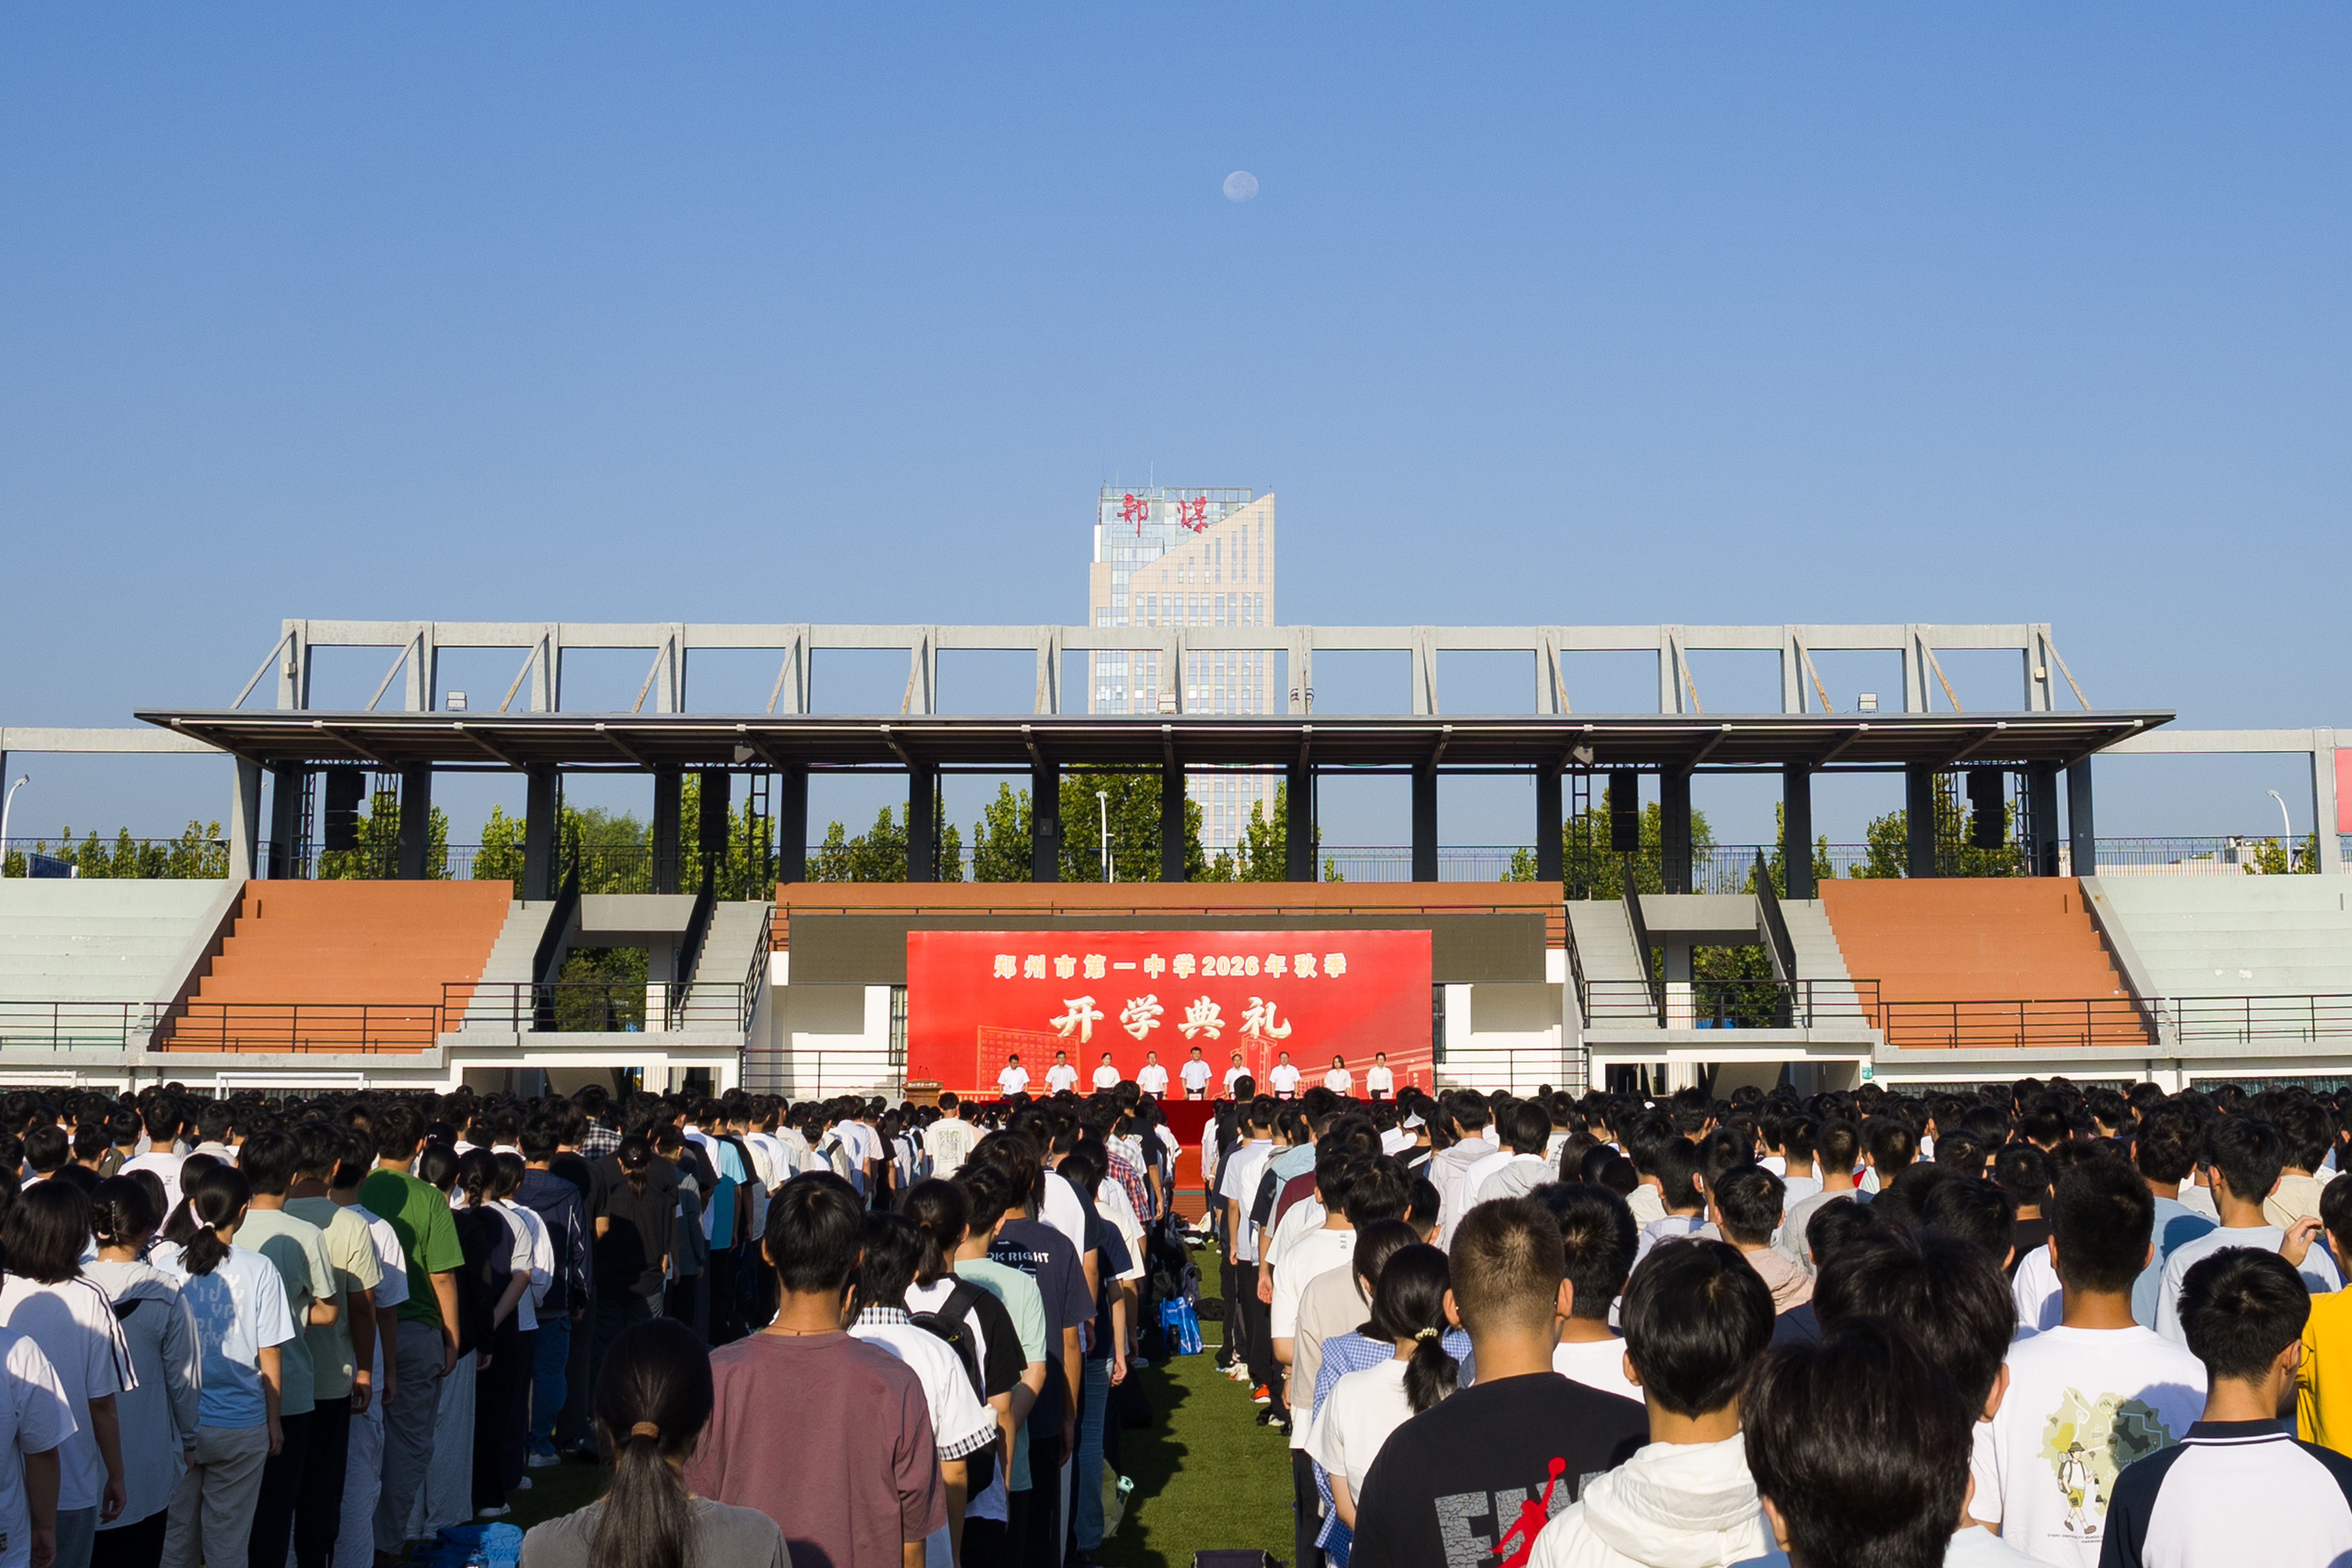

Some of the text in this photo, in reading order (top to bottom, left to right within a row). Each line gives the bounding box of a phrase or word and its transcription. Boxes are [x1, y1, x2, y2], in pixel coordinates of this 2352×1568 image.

[994, 953, 1347, 979] 郑州市第一中学2026年秋季
[1049, 994, 1292, 1043] 开学典礼
[1009, 1251, 1049, 1263] RIGHT
